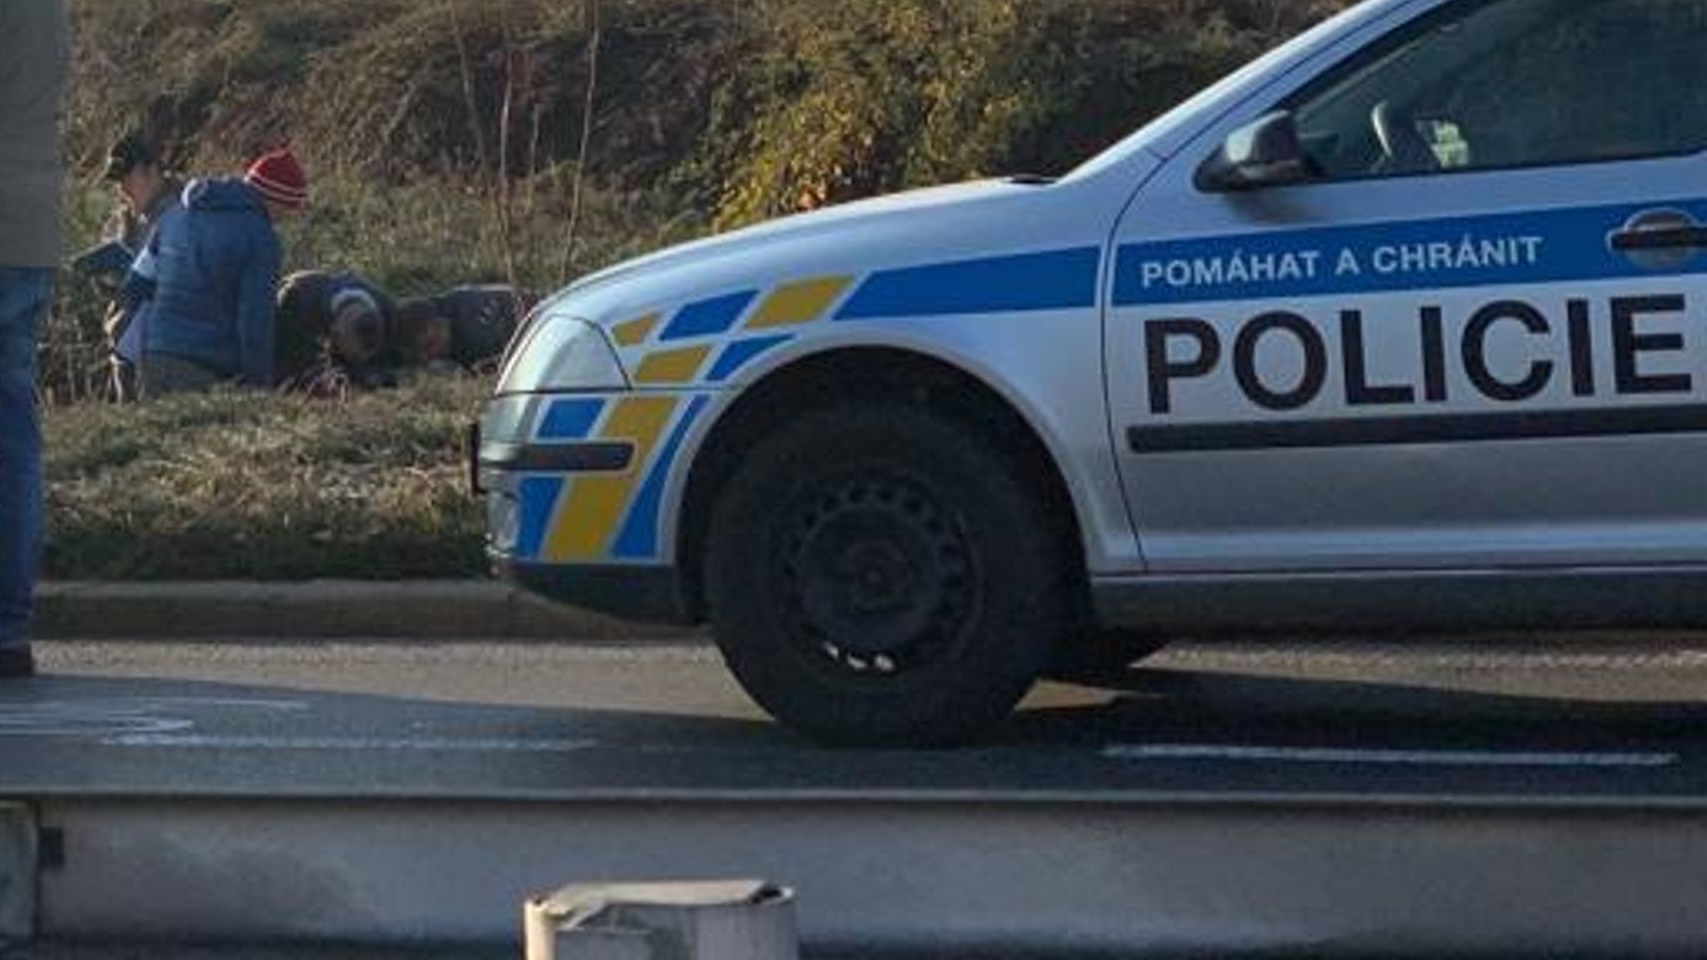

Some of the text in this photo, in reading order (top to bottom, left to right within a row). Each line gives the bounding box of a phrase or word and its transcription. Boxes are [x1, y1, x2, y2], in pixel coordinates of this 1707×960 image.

[1142, 235, 1543, 287] POMÁHAT A CHRÁNIT
[1144, 294, 1693, 414] POLICIE
